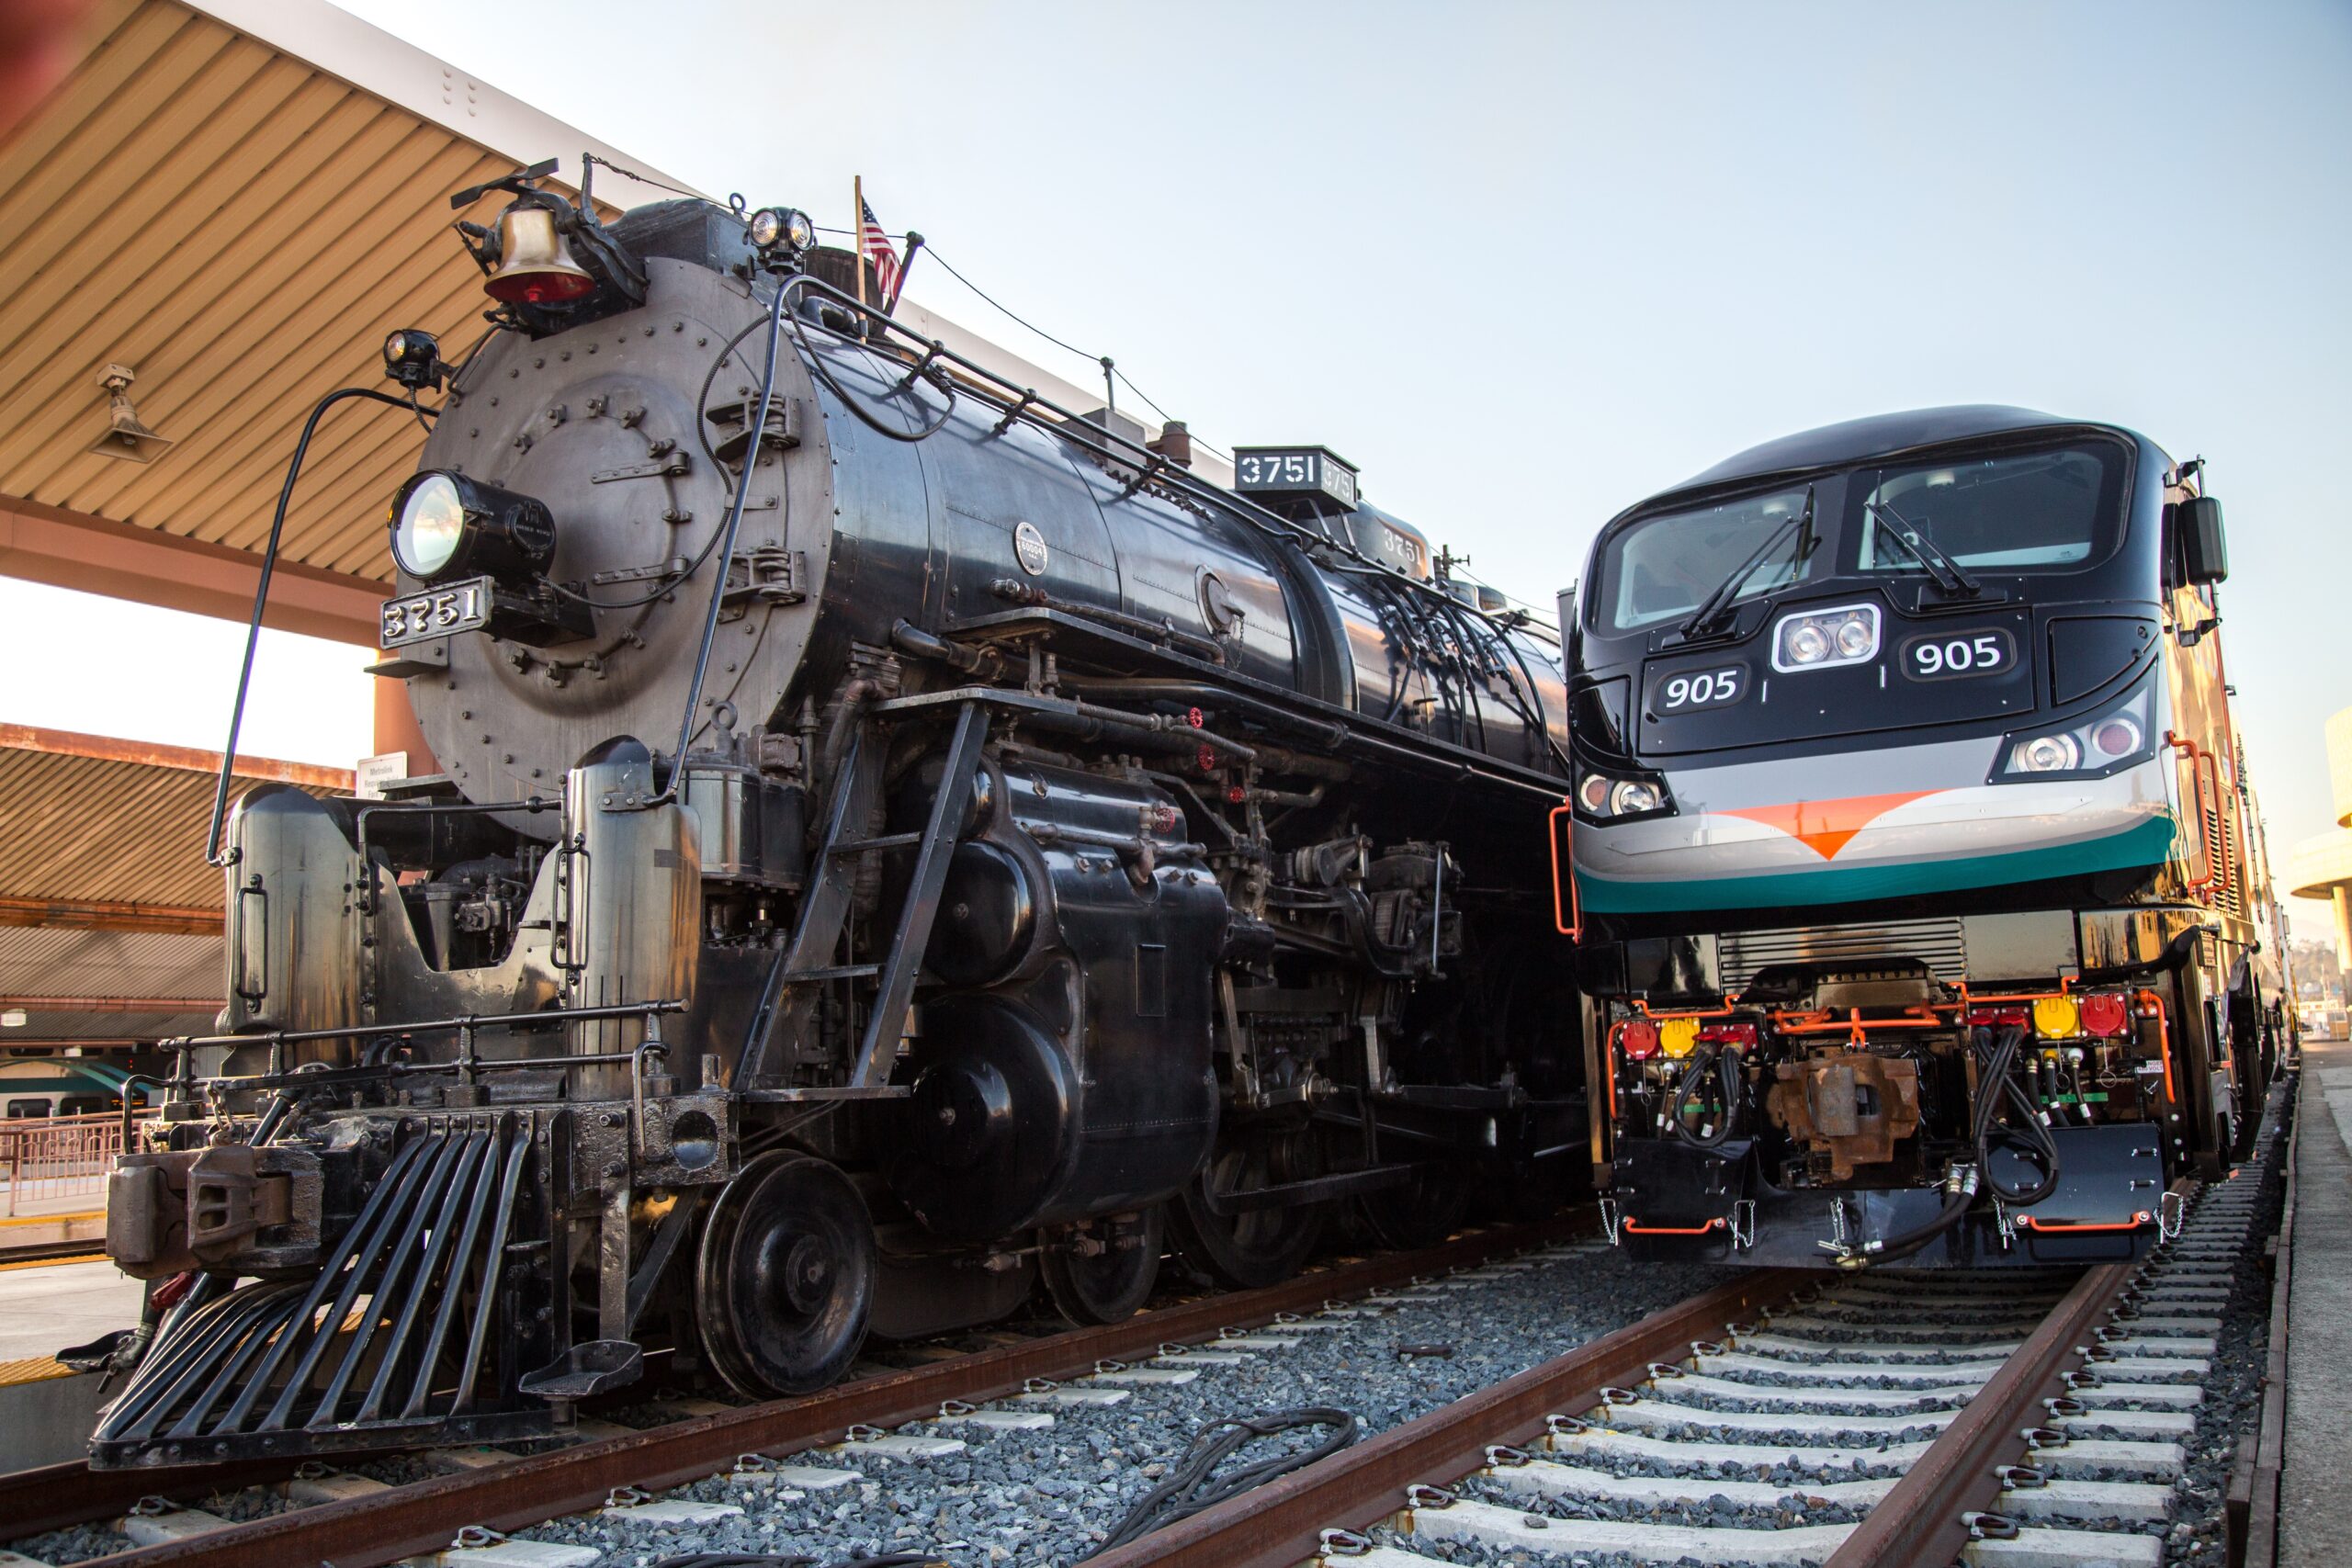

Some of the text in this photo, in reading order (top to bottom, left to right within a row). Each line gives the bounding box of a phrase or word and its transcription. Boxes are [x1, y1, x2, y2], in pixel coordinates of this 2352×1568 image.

[1241, 456, 1314, 483] 3751
[1323, 459, 1355, 503] 3751
[1022, 541, 1043, 557] 60004
[1384, 528, 1420, 565] 3751
[384, 589, 481, 637] 3751
[1916, 637, 2001, 674] 905
[1666, 671, 1737, 707] 905
